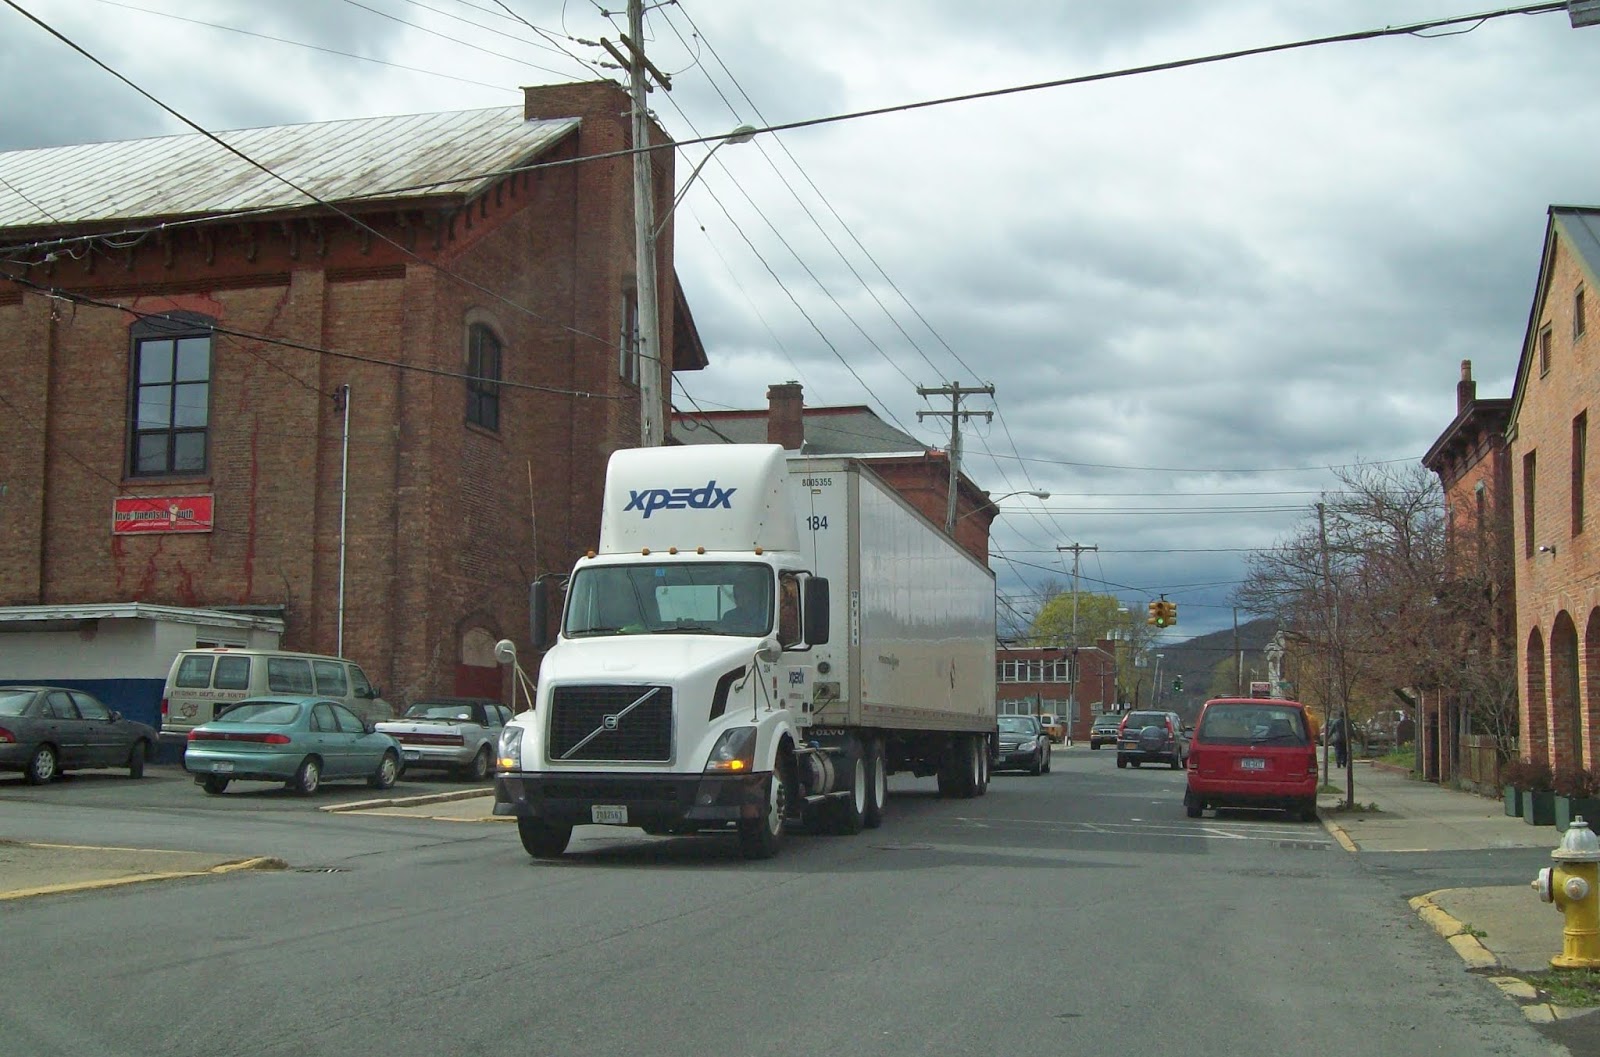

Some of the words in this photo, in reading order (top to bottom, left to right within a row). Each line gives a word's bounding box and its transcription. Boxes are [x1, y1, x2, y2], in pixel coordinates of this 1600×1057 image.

[802, 478, 832, 487] 8005355
[623, 480, 737, 519] xpedx
[115, 511, 160, 522] Invetments
[806, 516, 828, 531] 184
